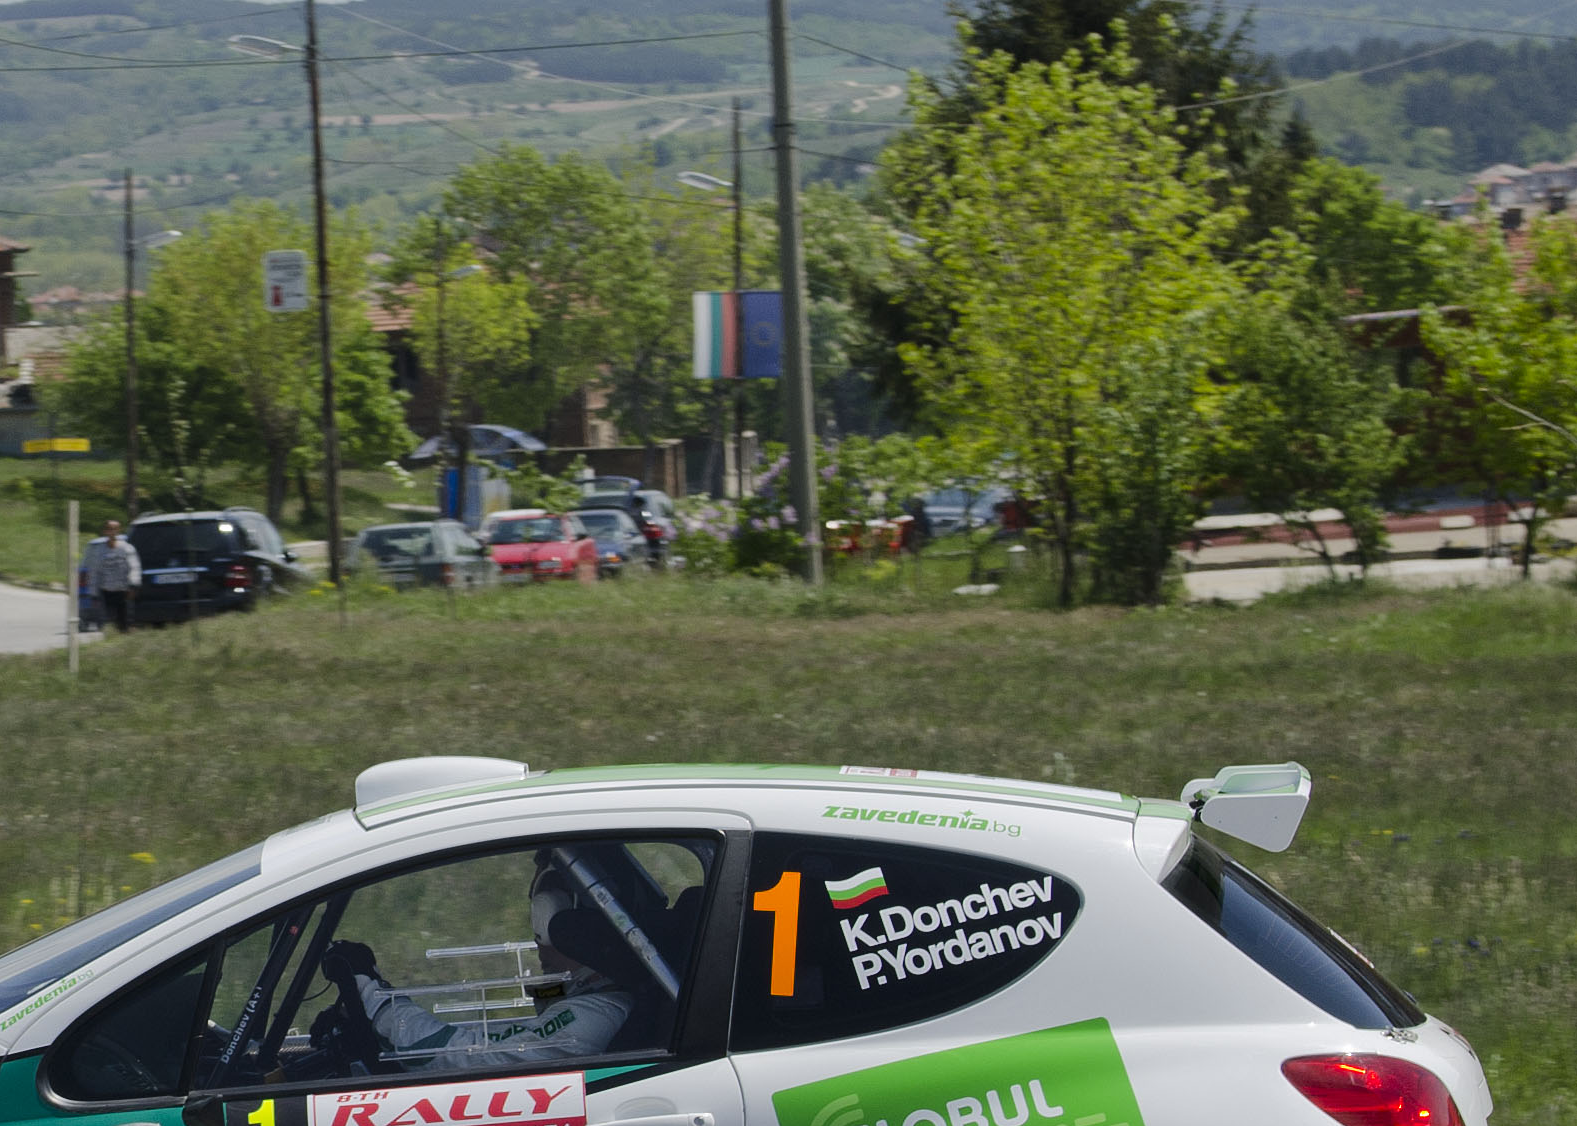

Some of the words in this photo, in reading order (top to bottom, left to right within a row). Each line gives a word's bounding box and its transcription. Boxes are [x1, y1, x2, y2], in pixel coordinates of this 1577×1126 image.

[822, 805, 1022, 838] zavedenia.bg
[753, 871, 801, 997] 1
[840, 876, 1054, 952] K.Donchev
[852, 911, 1063, 990] P.Yordanov
[0, 969, 95, 1032] zavedenia.bg
[221, 1013, 250, 1065] Donchev
[337, 1091, 390, 1103] 8-TH
